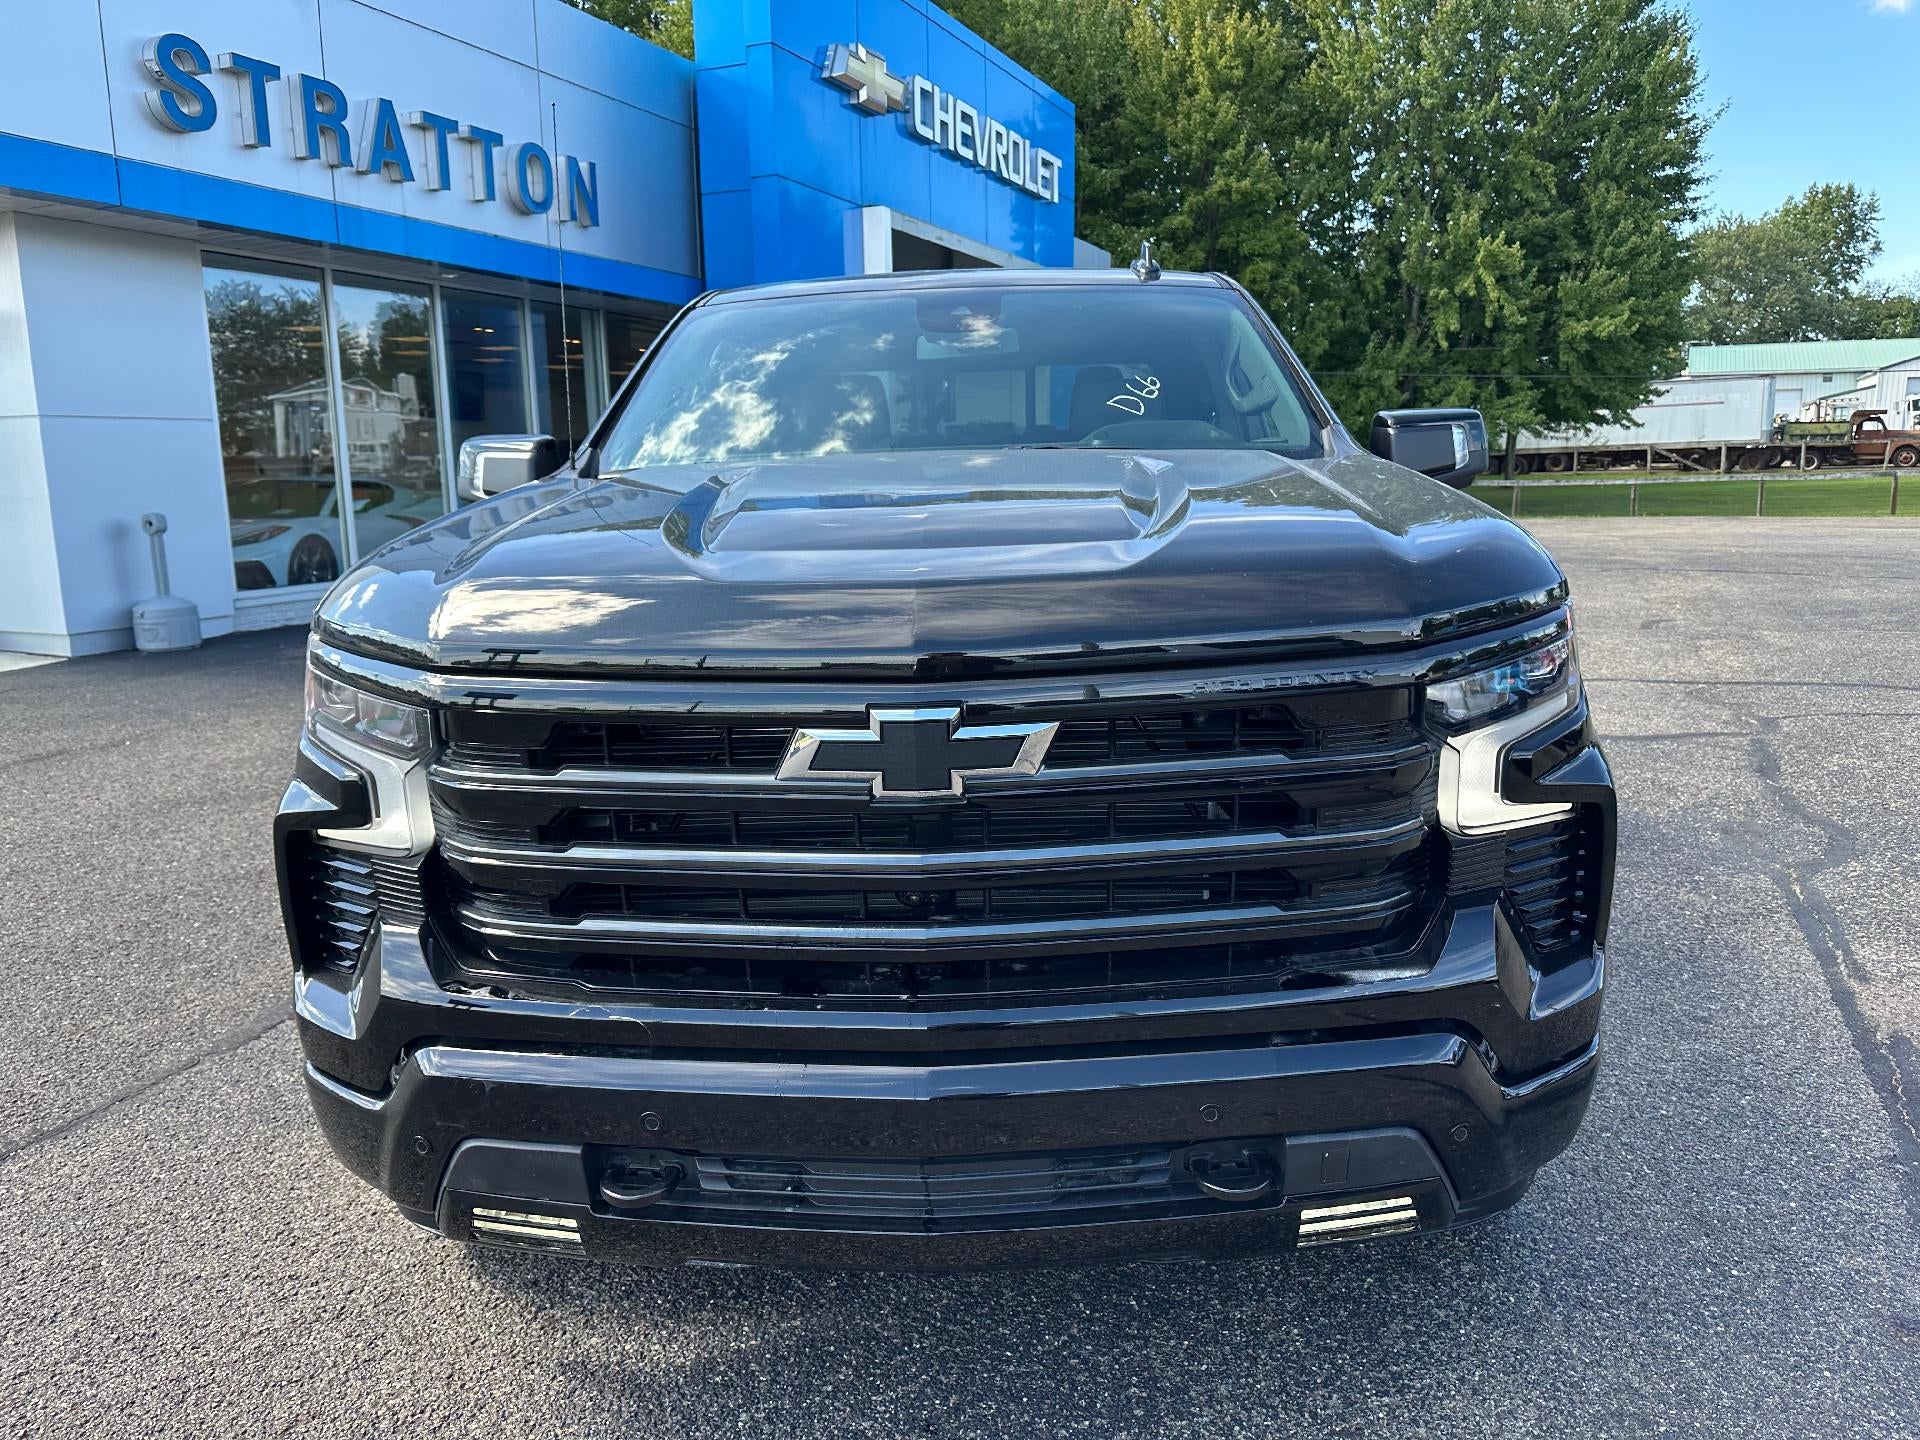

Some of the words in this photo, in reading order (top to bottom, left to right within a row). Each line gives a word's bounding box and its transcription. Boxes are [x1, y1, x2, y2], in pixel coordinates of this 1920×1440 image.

[144, 33, 599, 227] STRATTON
[908, 74, 1062, 204] CHEVROLET
[1106, 374, 1161, 416] D66
[1193, 678, 1253, 695] HIGH
[1262, 669, 1378, 689] COUNTRY
